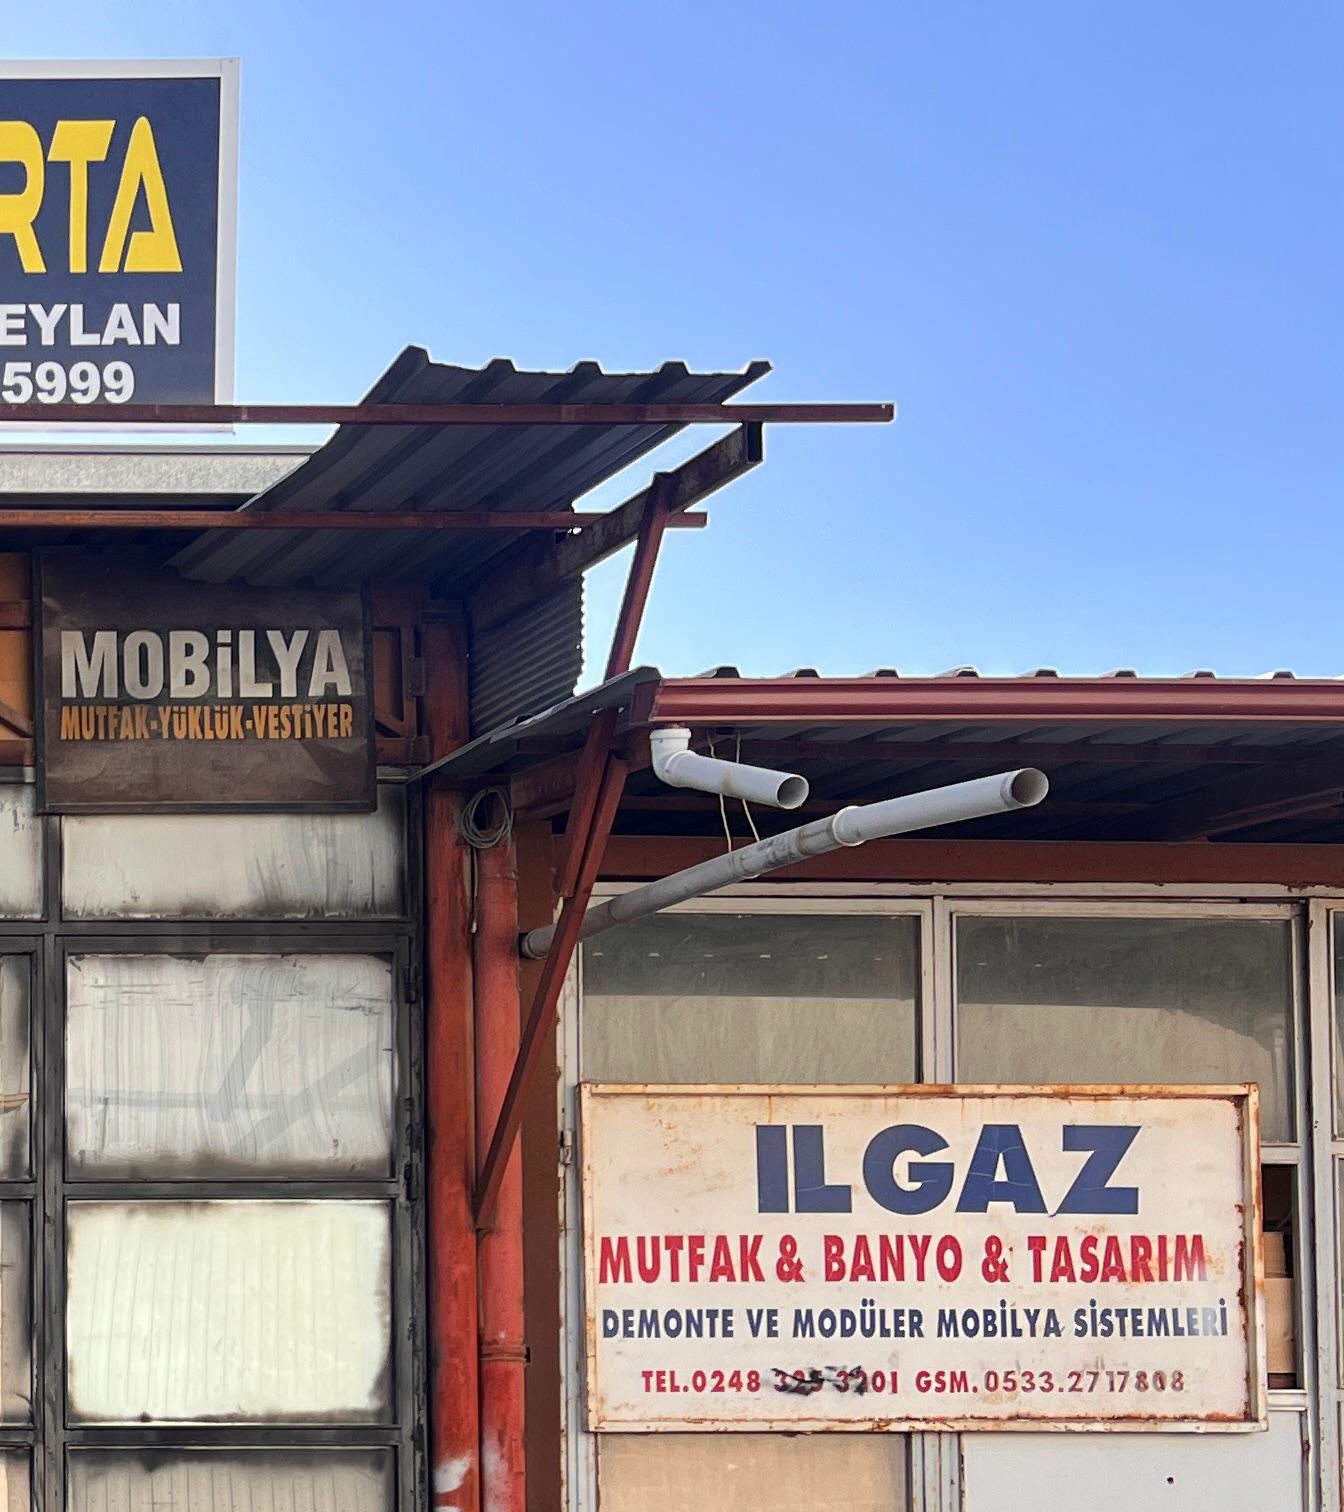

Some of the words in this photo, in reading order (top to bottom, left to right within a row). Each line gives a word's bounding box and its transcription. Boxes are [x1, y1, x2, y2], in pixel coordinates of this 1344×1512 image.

[1, 361, 135, 404] 5999
[755, 1123, 1142, 1215] ILGAZ
[598, 1234, 766, 1284] MUTFAK
[775, 1234, 806, 1283] &
[823, 1234, 963, 1283] BANYO
[981, 1234, 1011, 1283] &
[1026, 1234, 1208, 1283] TASARIM
[602, 1308, 734, 1338] DEMONTE
[746, 1308, 779, 1338] VE
[792, 1298, 925, 1338] MODÜLER
[936, 1298, 1062, 1338] MOBİLYA
[1073, 1297, 1228, 1338] SİSTEMLERİ
